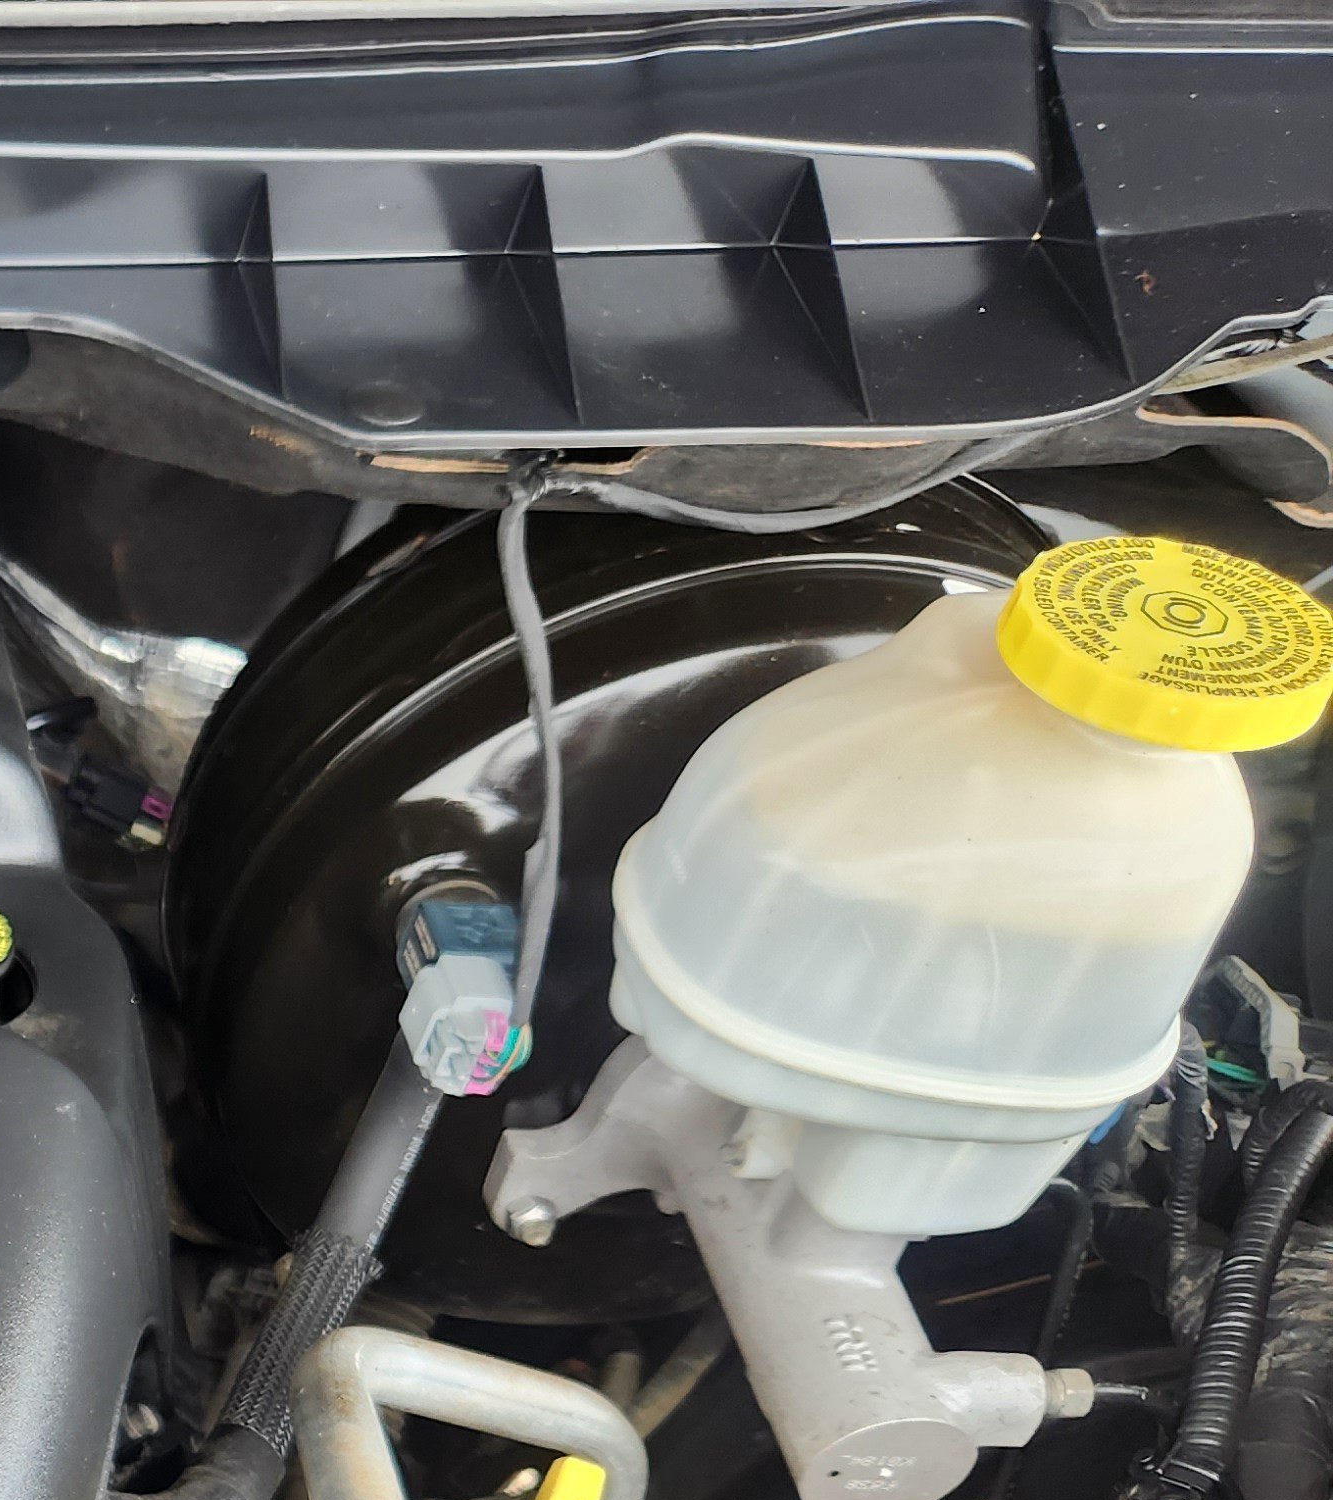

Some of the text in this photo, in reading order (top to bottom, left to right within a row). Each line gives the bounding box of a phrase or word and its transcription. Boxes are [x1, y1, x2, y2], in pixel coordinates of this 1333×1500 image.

[1191, 568, 1217, 582] DU
[1216, 578, 1276, 613] LIQUIDE
[1061, 606, 1089, 625] USE
[1080, 628, 1123, 652] ONLY
[1088, 612, 1118, 632] CAP
[1154, 665, 1268, 685] UNIQUEMENT
